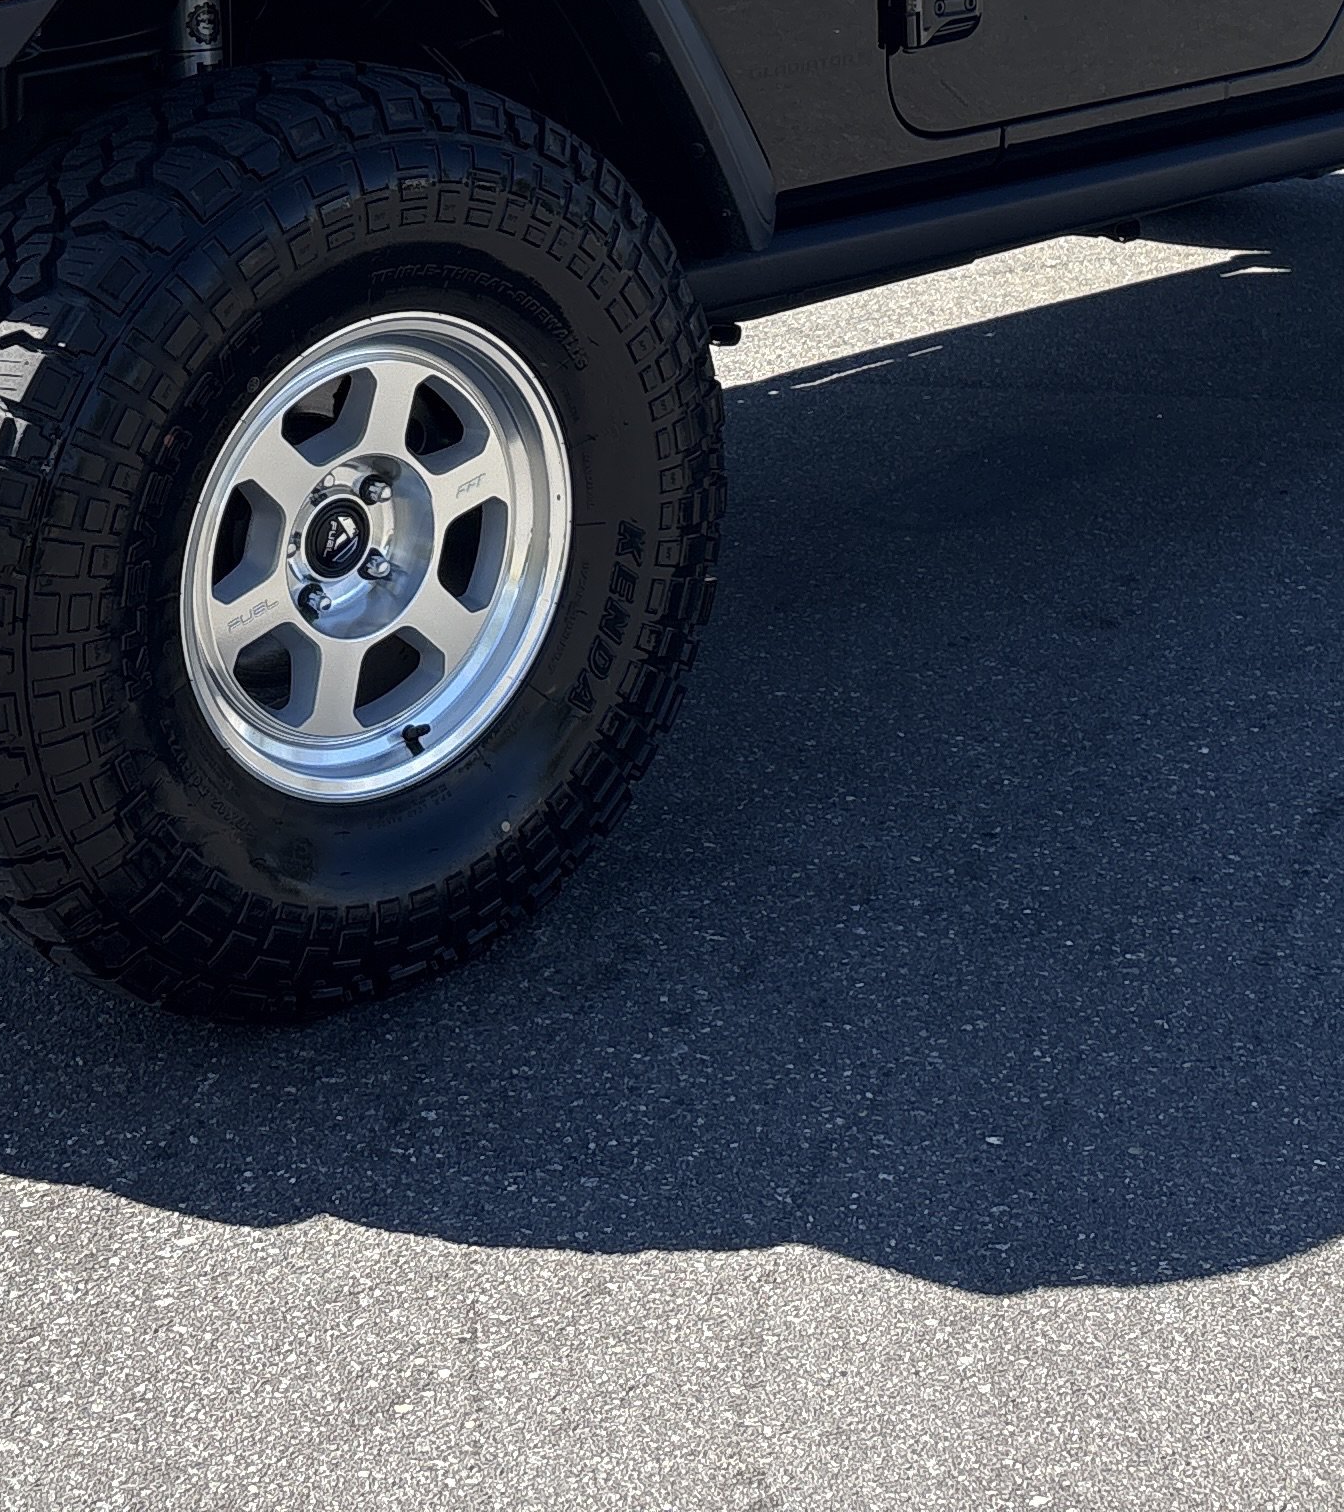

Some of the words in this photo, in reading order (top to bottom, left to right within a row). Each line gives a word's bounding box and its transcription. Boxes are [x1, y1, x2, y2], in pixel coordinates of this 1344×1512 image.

[120, 425, 192, 701] KLEVER
[183, 311, 263, 423] R/T
[322, 520, 338, 558] FUEL
[226, 598, 279, 633] FUEL
[567, 519, 645, 714] KENDA
